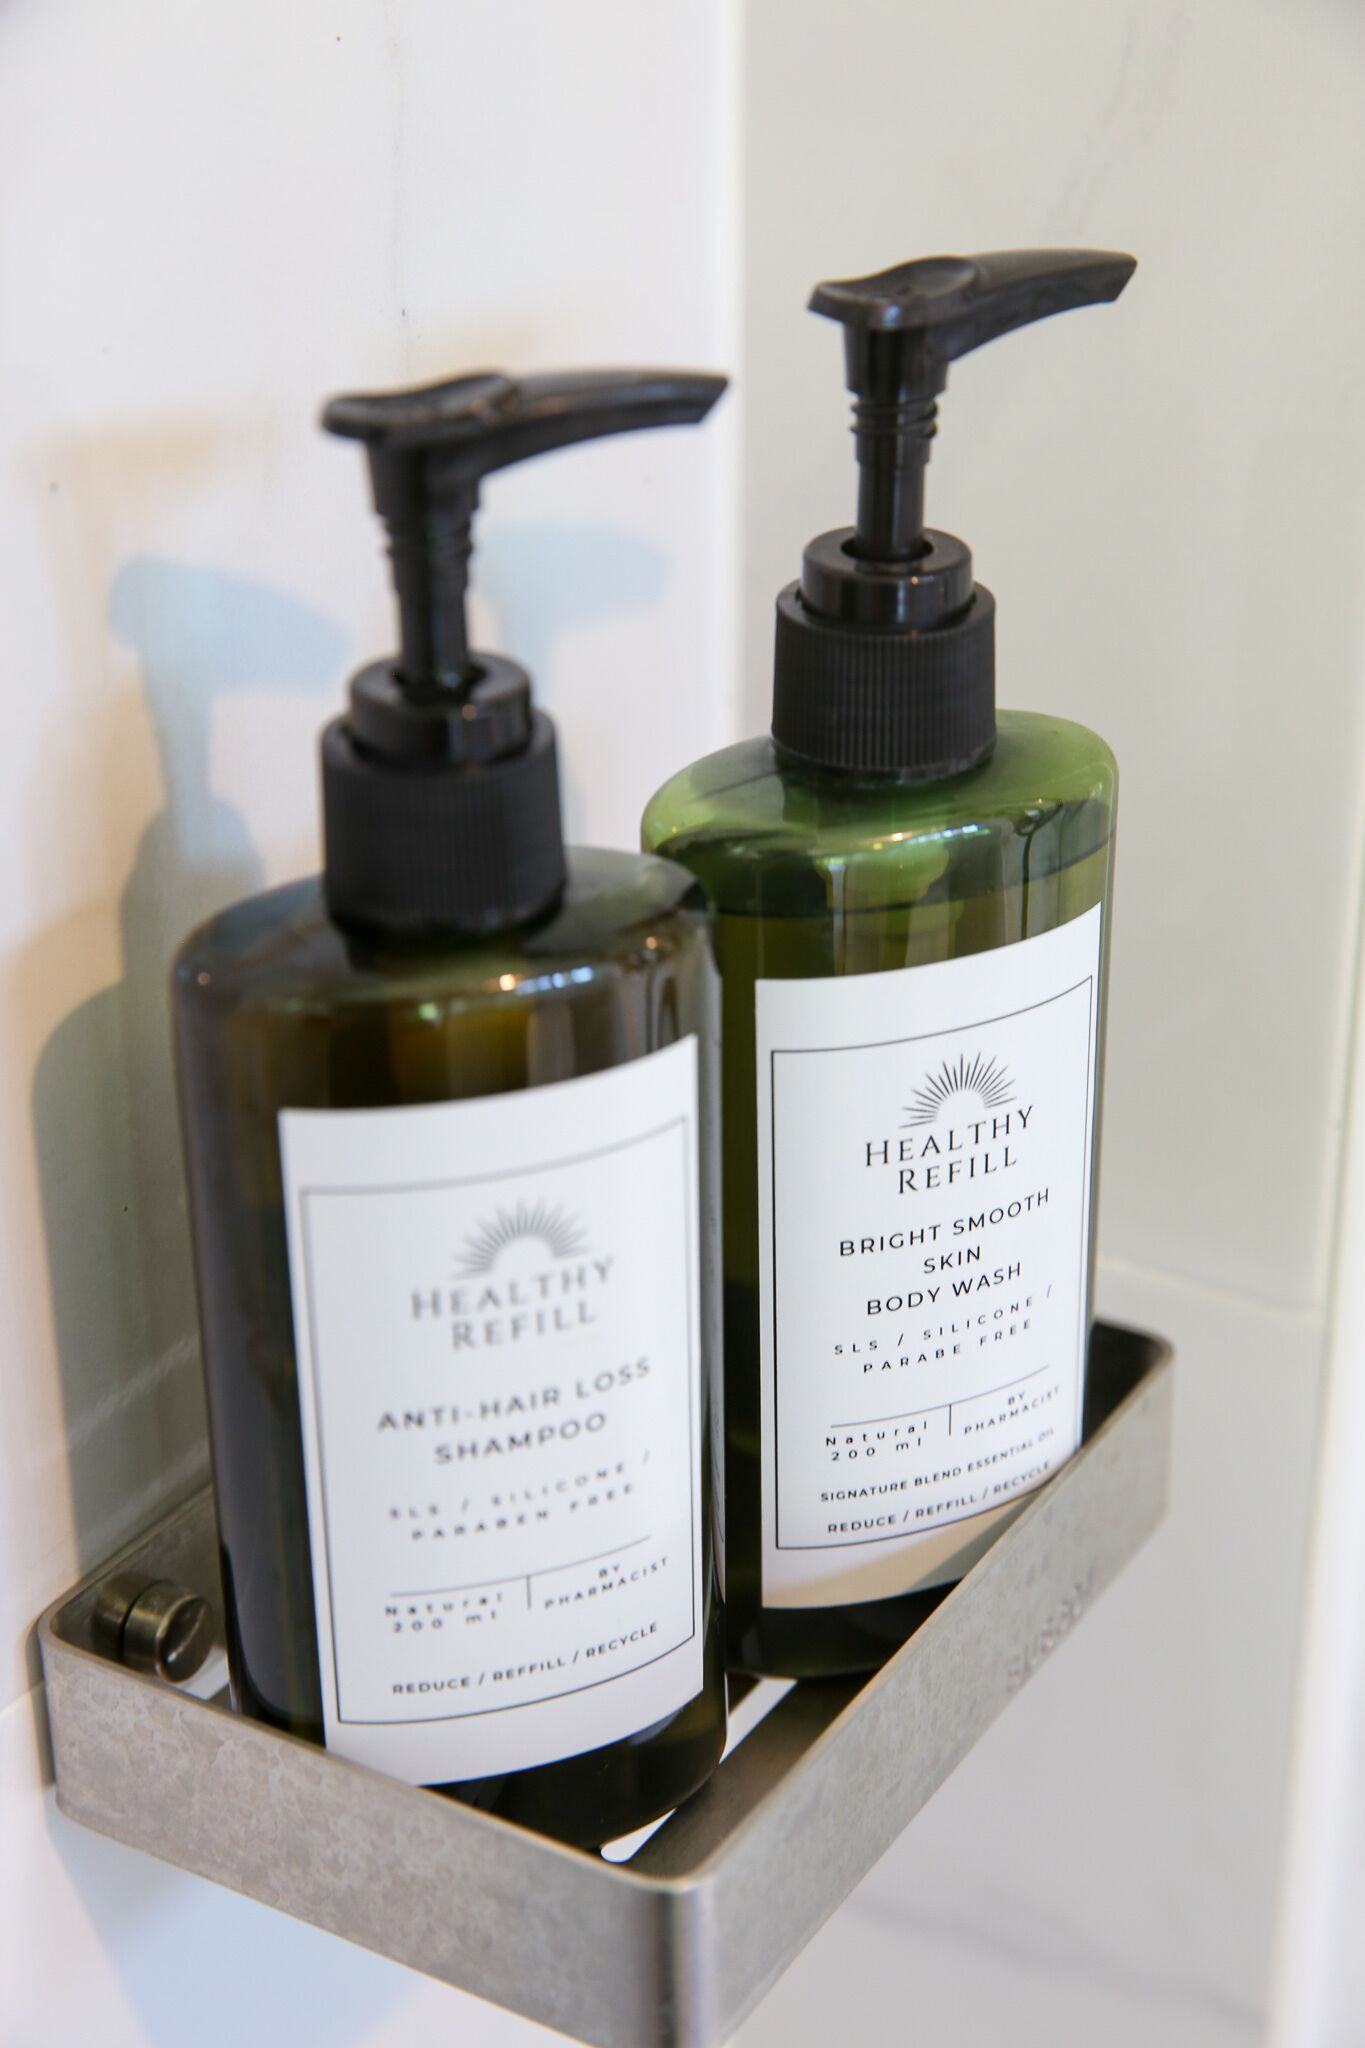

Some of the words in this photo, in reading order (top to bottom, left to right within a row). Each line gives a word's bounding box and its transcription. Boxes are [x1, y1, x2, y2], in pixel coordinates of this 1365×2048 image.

[865, 1105, 1034, 1167] HEALTHY
[898, 1146, 1018, 1194] REFILL
[839, 1224, 942, 1257] BRIGHT
[952, 1187, 1049, 1236] SMOOTH
[923, 1245, 981, 1275] SKIN
[410, 1254, 615, 1322] HEALTHY
[866, 1286, 941, 1315] BODY
[952, 1261, 1021, 1297] WASH
[451, 1298, 597, 1351] REFILL
[833, 1339, 879, 1356] SLS
[922, 1296, 1033, 1341] SILICONE
[863, 1343, 962, 1374] PARABE
[979, 1318, 1031, 1347] FREE
[377, 1386, 562, 1433] ANTI-HAIR
[575, 1356, 650, 1400] LOSS
[964, 1385, 1059, 1436] PHARMACIST
[1008, 1391, 1026, 1406] BY
[434, 1411, 607, 1465] SHAMPOO
[825, 1420, 928, 1447] Natural
[831, 1446, 876, 1462] 200
[895, 1437, 922, 1452] ml
[388, 1503, 439, 1521] SLS
[491, 1461, 625, 1508] SILICONE
[820, 1480, 908, 1503] SIGNATURE
[914, 1467, 962, 1487] BLEND
[967, 1438, 1033, 1473] ESSENTIAL
[827, 1514, 897, 1534] REDUCE
[915, 1494, 977, 1519] REFFILL
[993, 1460, 1050, 1495] RECYCLE
[411, 1508, 549, 1542] PARABEN
[569, 1482, 633, 1512] FREE
[544, 1555, 669, 1610] PHARMACIST
[599, 1564, 621, 1579] BY
[384, 1592, 502, 1617] Natural
[392, 1618, 443, 1634] 200
[465, 1610, 496, 1625] ml
[392, 1676, 471, 1695] REDUCE
[492, 1656, 567, 1683] REFFILL
[586, 1621, 659, 1660] RECYCLE
